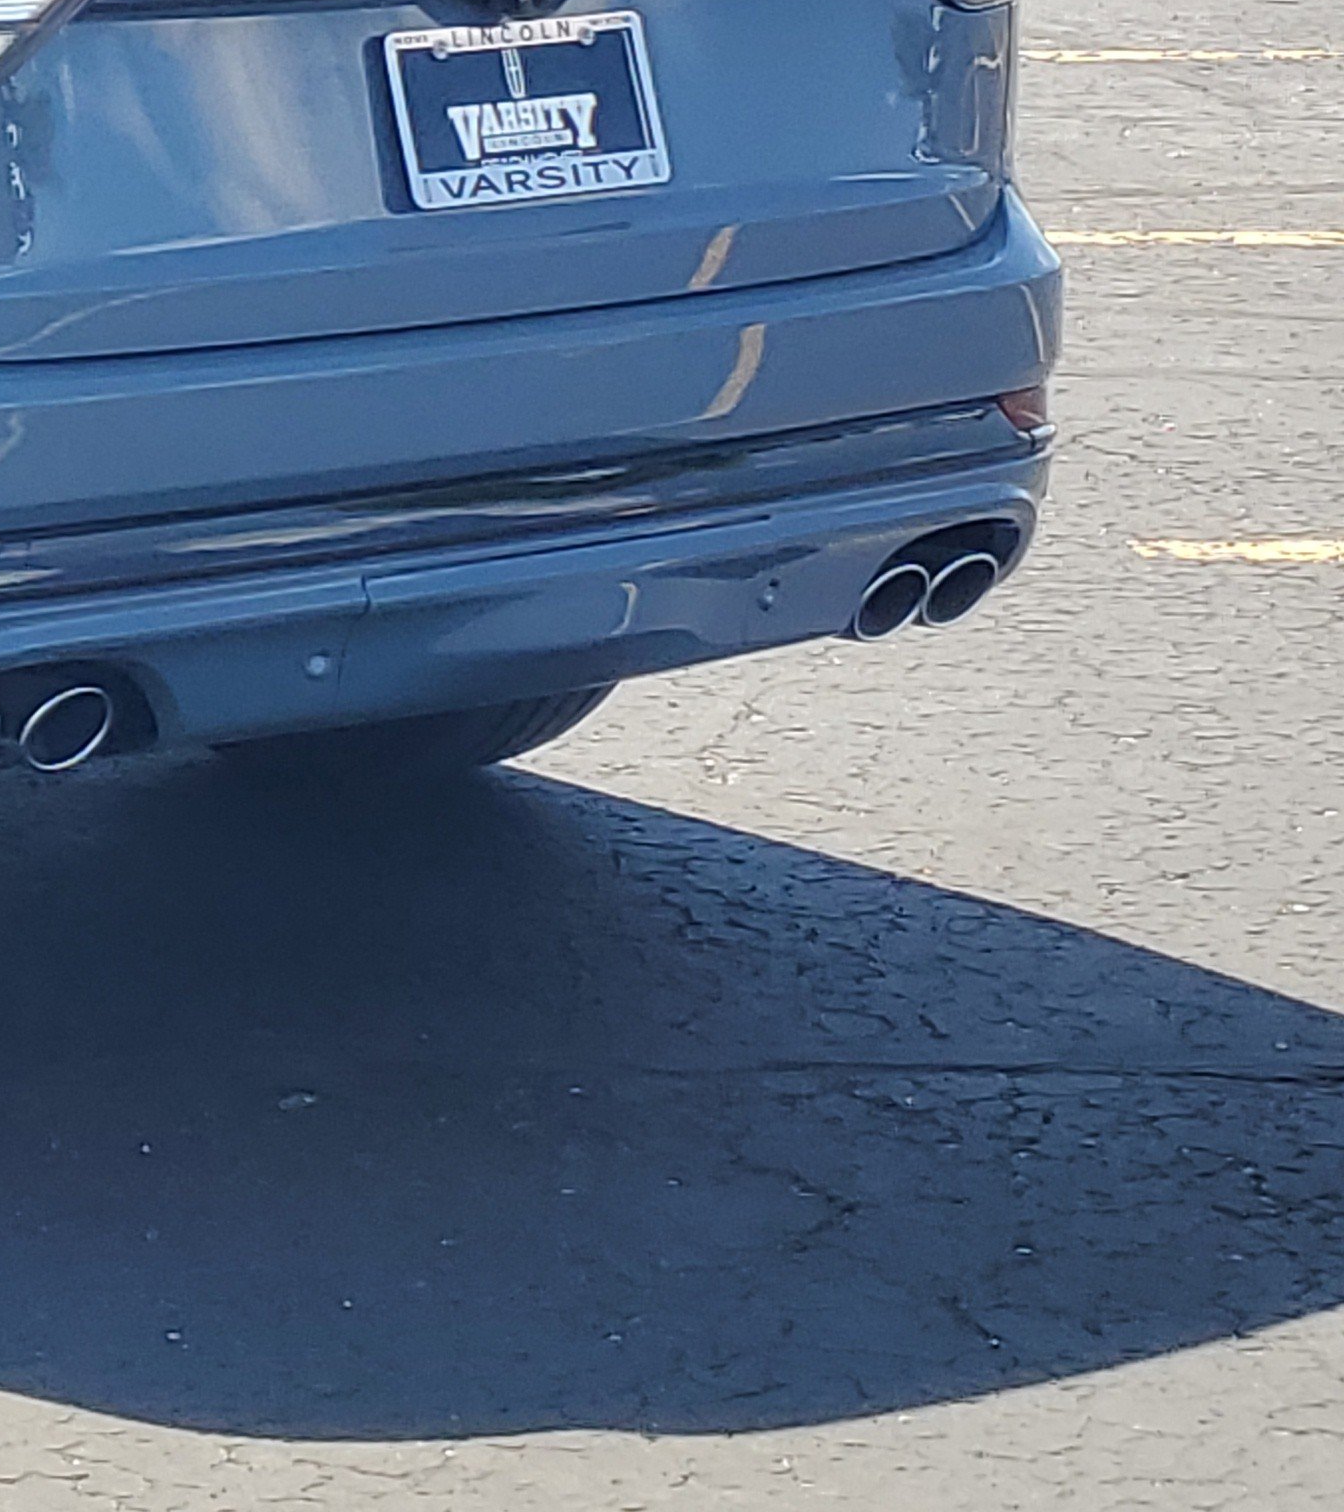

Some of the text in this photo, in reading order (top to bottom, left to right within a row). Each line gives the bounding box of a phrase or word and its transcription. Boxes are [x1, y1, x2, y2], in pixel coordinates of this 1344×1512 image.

[450, 20, 571, 48] LINCOLN
[447, 93, 597, 160] VARSITY
[439, 157, 639, 198] VARSITY
